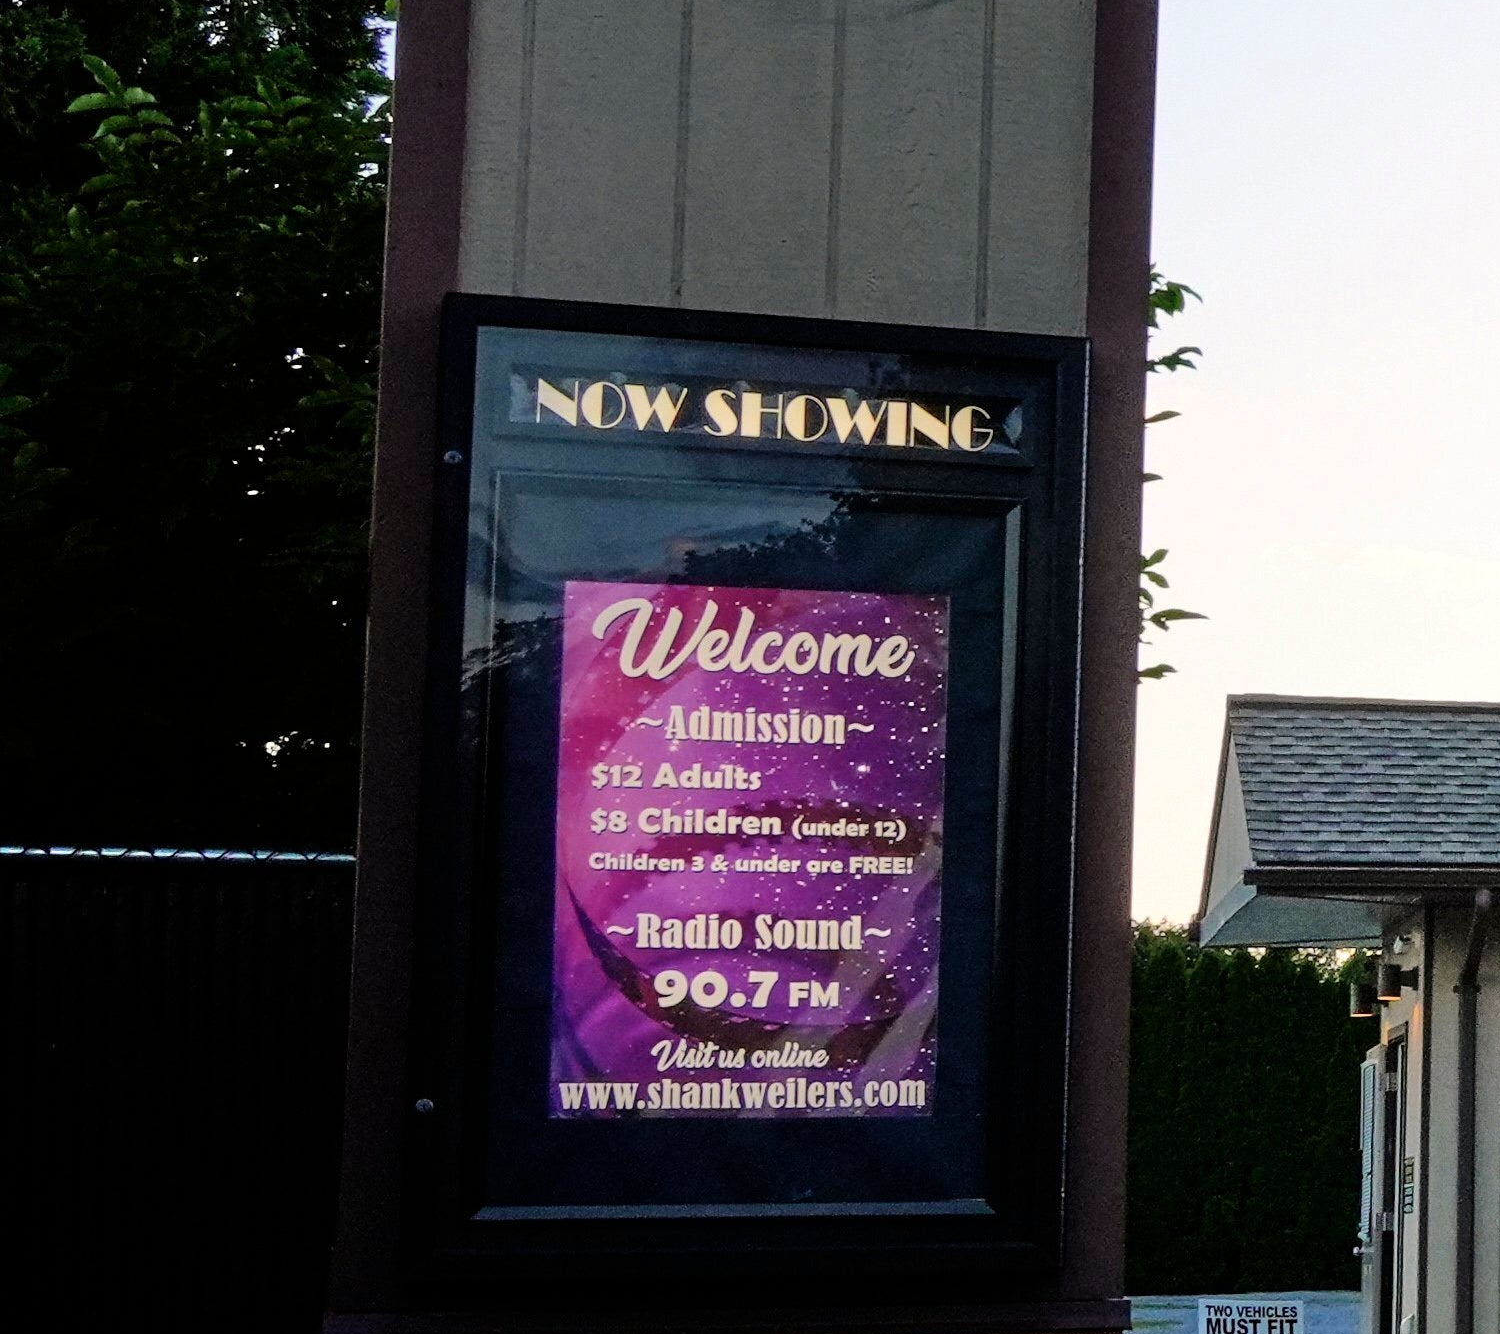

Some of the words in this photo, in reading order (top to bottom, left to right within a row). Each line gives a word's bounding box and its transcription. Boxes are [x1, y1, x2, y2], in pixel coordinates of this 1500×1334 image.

[536, 378, 688, 433] NOW
[703, 388, 993, 452] SHOWING
[592, 597, 916, 679] Welcome
[591, 762, 643, 790] $12
[652, 762, 762, 791] Adults
[590, 807, 629, 835] $8
[638, 807, 782, 836] Children
[791, 815, 869, 839] (under
[874, 819, 907, 842] 12)
[588, 852, 685, 872] Children
[691, 854, 705, 872] 3
[710, 854, 729, 873] &
[734, 855, 801, 874] under
[806, 858, 843, 876] are
[849, 856, 914, 875] FREE!
[653, 969, 779, 1009] 90.7
[789, 980, 840, 1009] FM
[651, 1038, 720, 1071] Visit
[718, 1046, 746, 1069] us
[751, 1040, 829, 1069] online
[559, 1077, 926, 1111] www.shankweilers.com
[1205, 1305, 1233, 1318] TWO
[1236, 1305, 1298, 1318] VEHICLES
